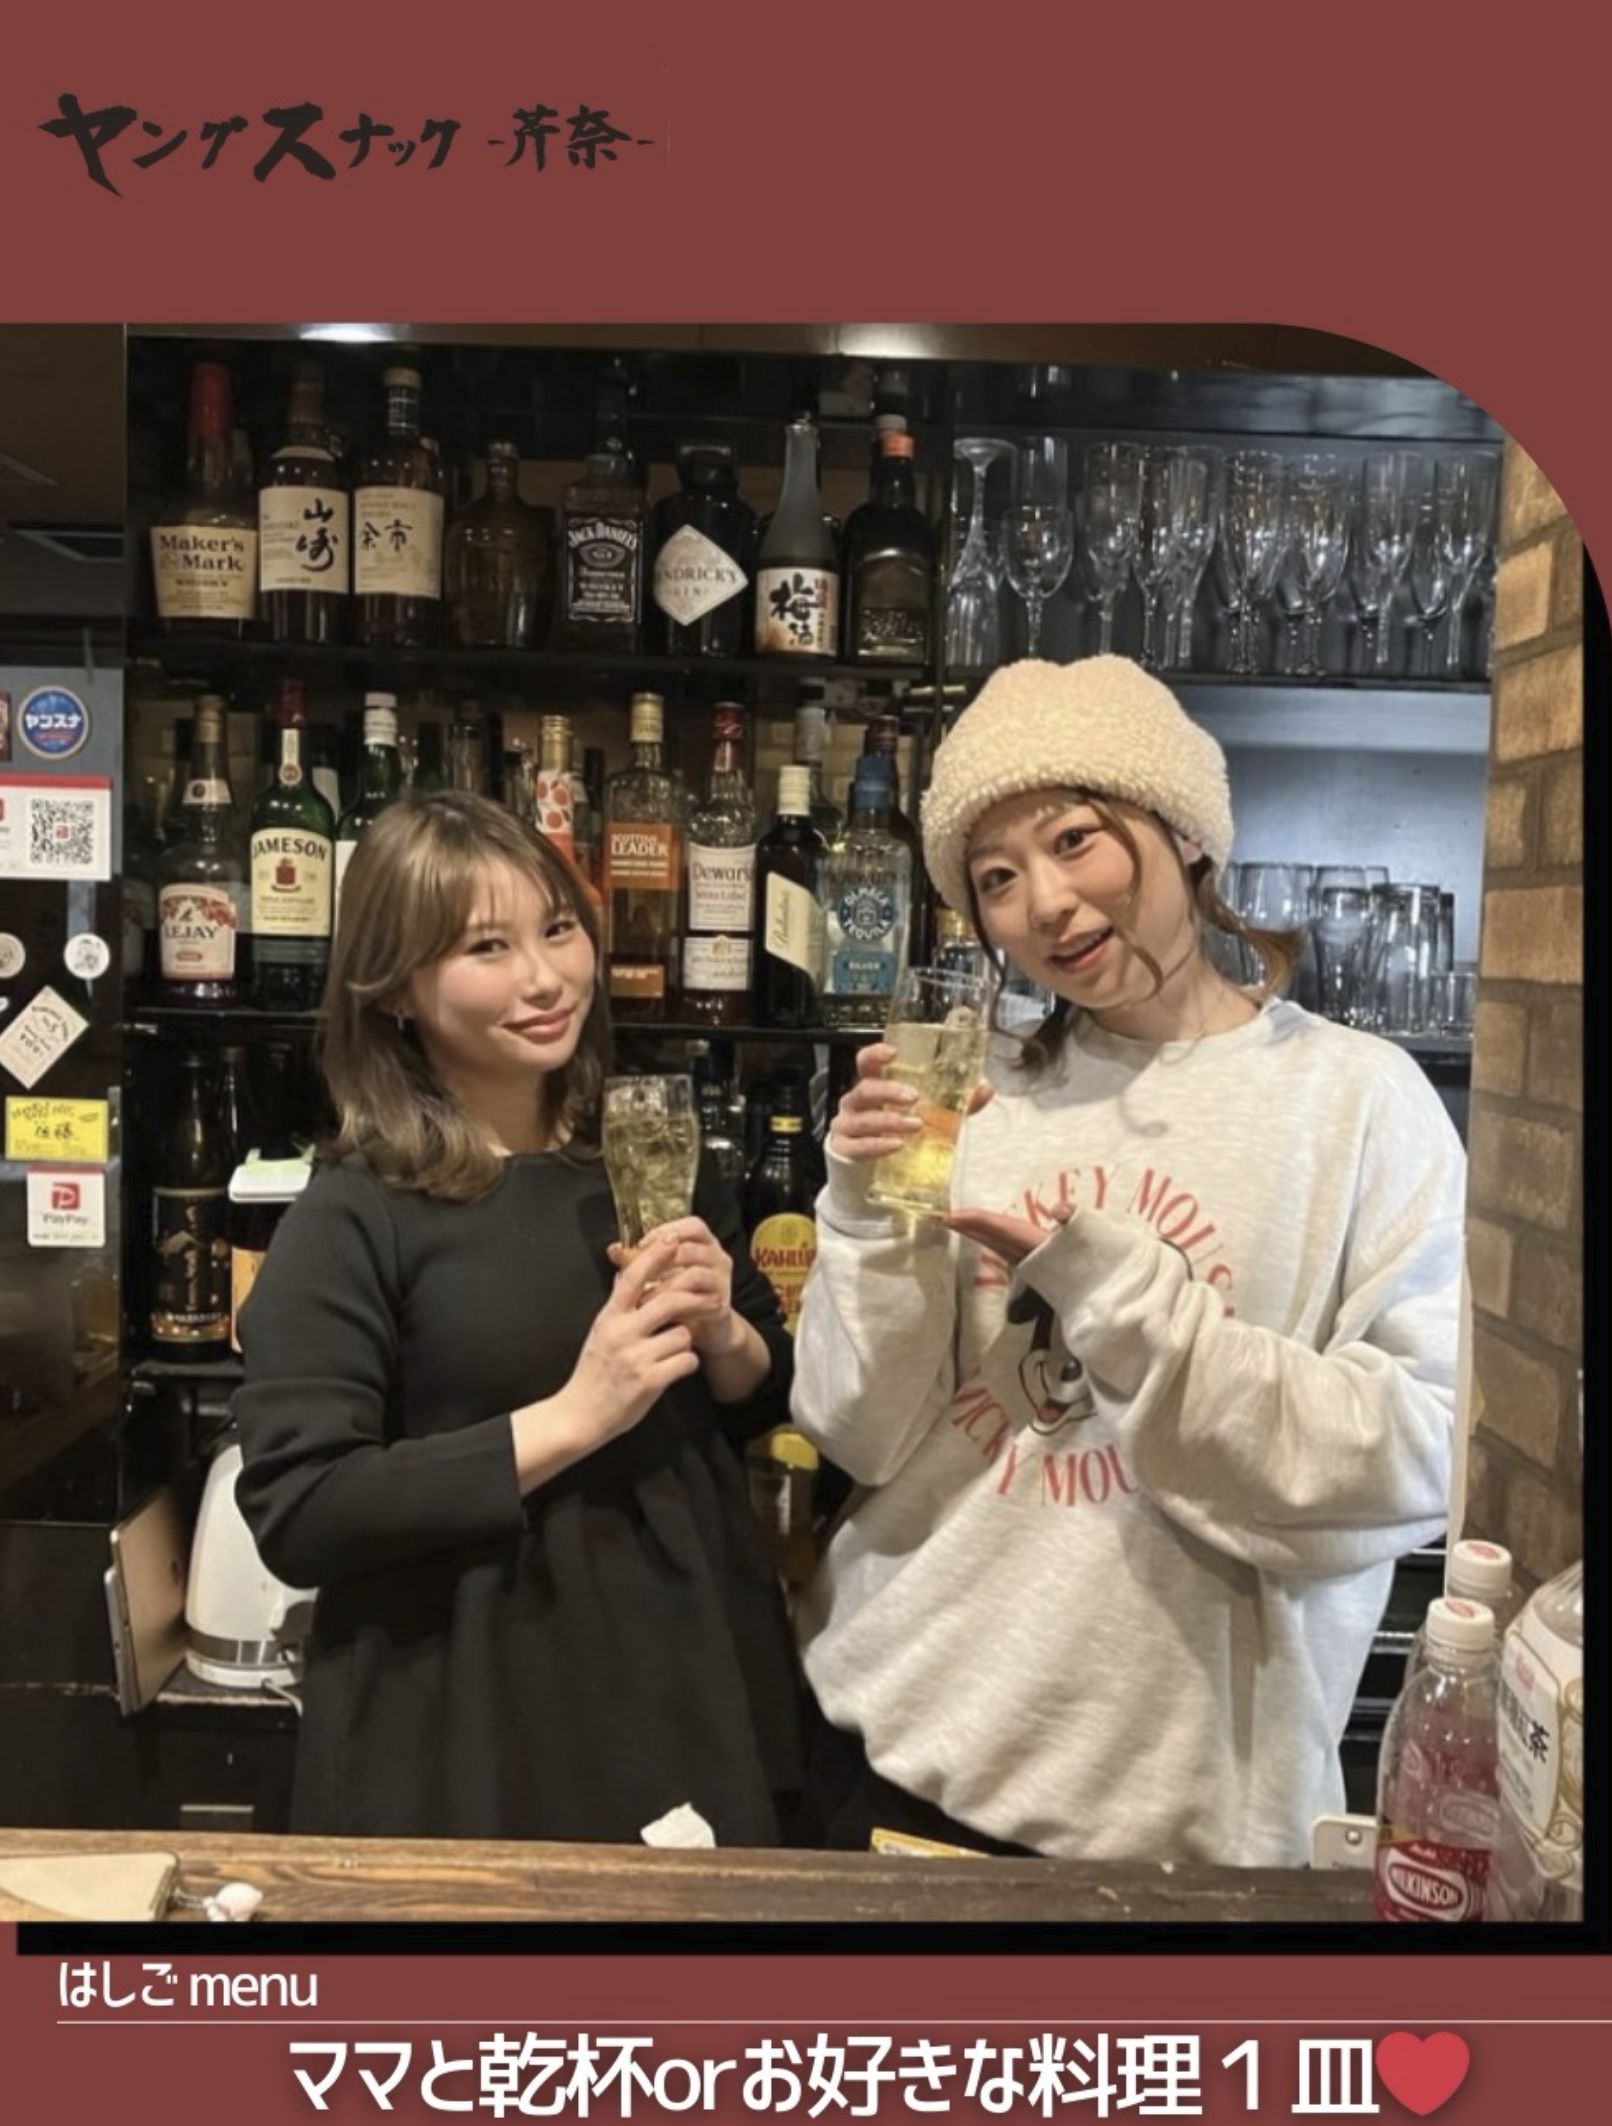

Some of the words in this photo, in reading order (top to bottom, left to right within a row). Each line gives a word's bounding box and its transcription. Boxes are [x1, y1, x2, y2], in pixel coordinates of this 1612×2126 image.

[159, 534, 245, 552] Maker's
[296, 498, 338, 572] 山崎
[360, 519, 413, 552] 余市
[182, 553, 245, 571] Mark
[769, 572, 820, 645] 梅酒
[253, 836, 328, 861] JAMESON
[611, 842, 669, 857] LEADER
[843, 917, 892, 940] TEQUILA
